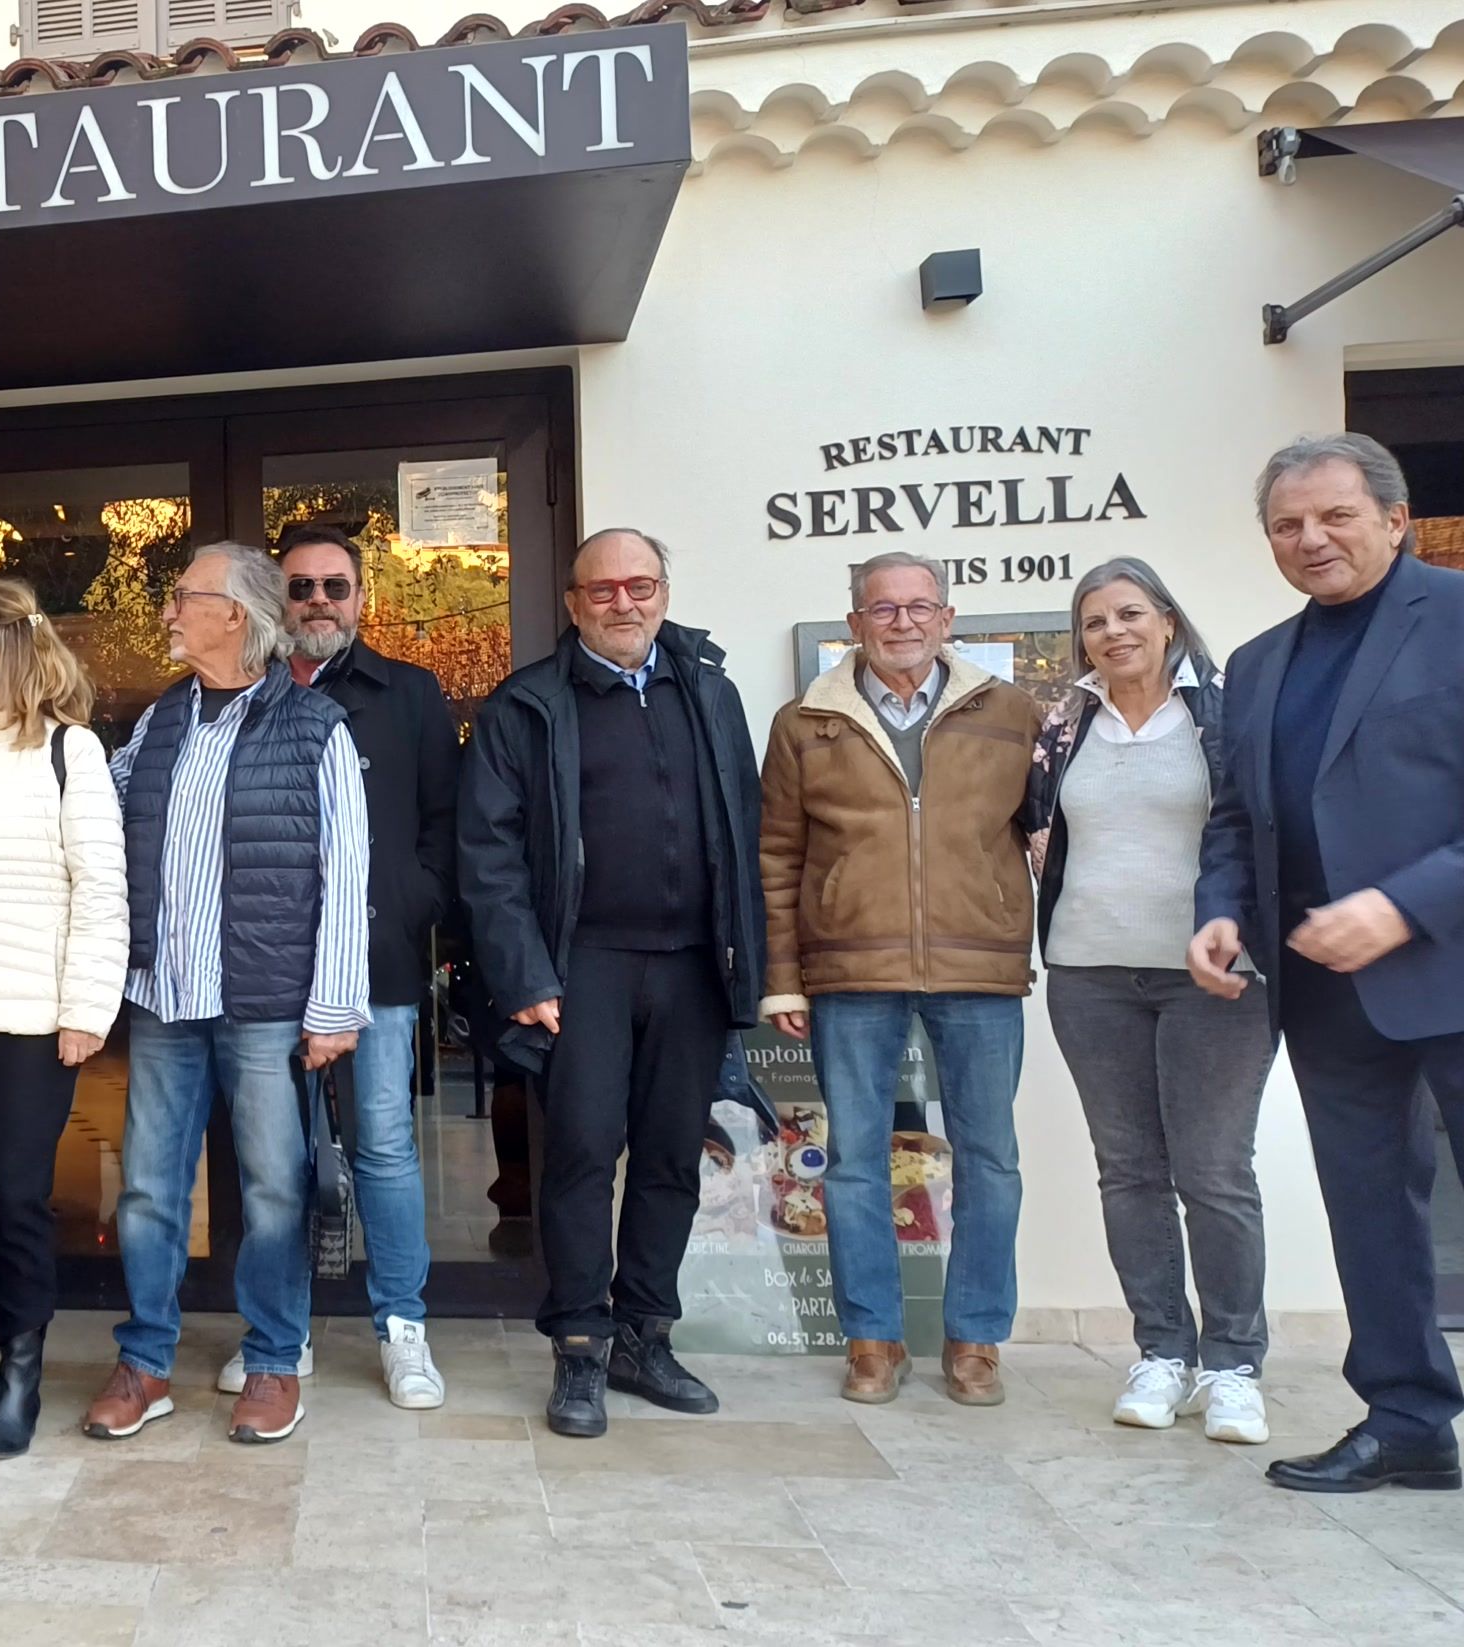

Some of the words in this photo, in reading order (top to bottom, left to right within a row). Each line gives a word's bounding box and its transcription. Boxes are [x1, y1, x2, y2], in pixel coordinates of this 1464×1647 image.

[820, 425, 1092, 472] RESTAURANT
[765, 472, 1148, 541] SERVELLA
[1000, 553, 1074, 584] 1901
[792, 1297, 837, 1318] PARTA
